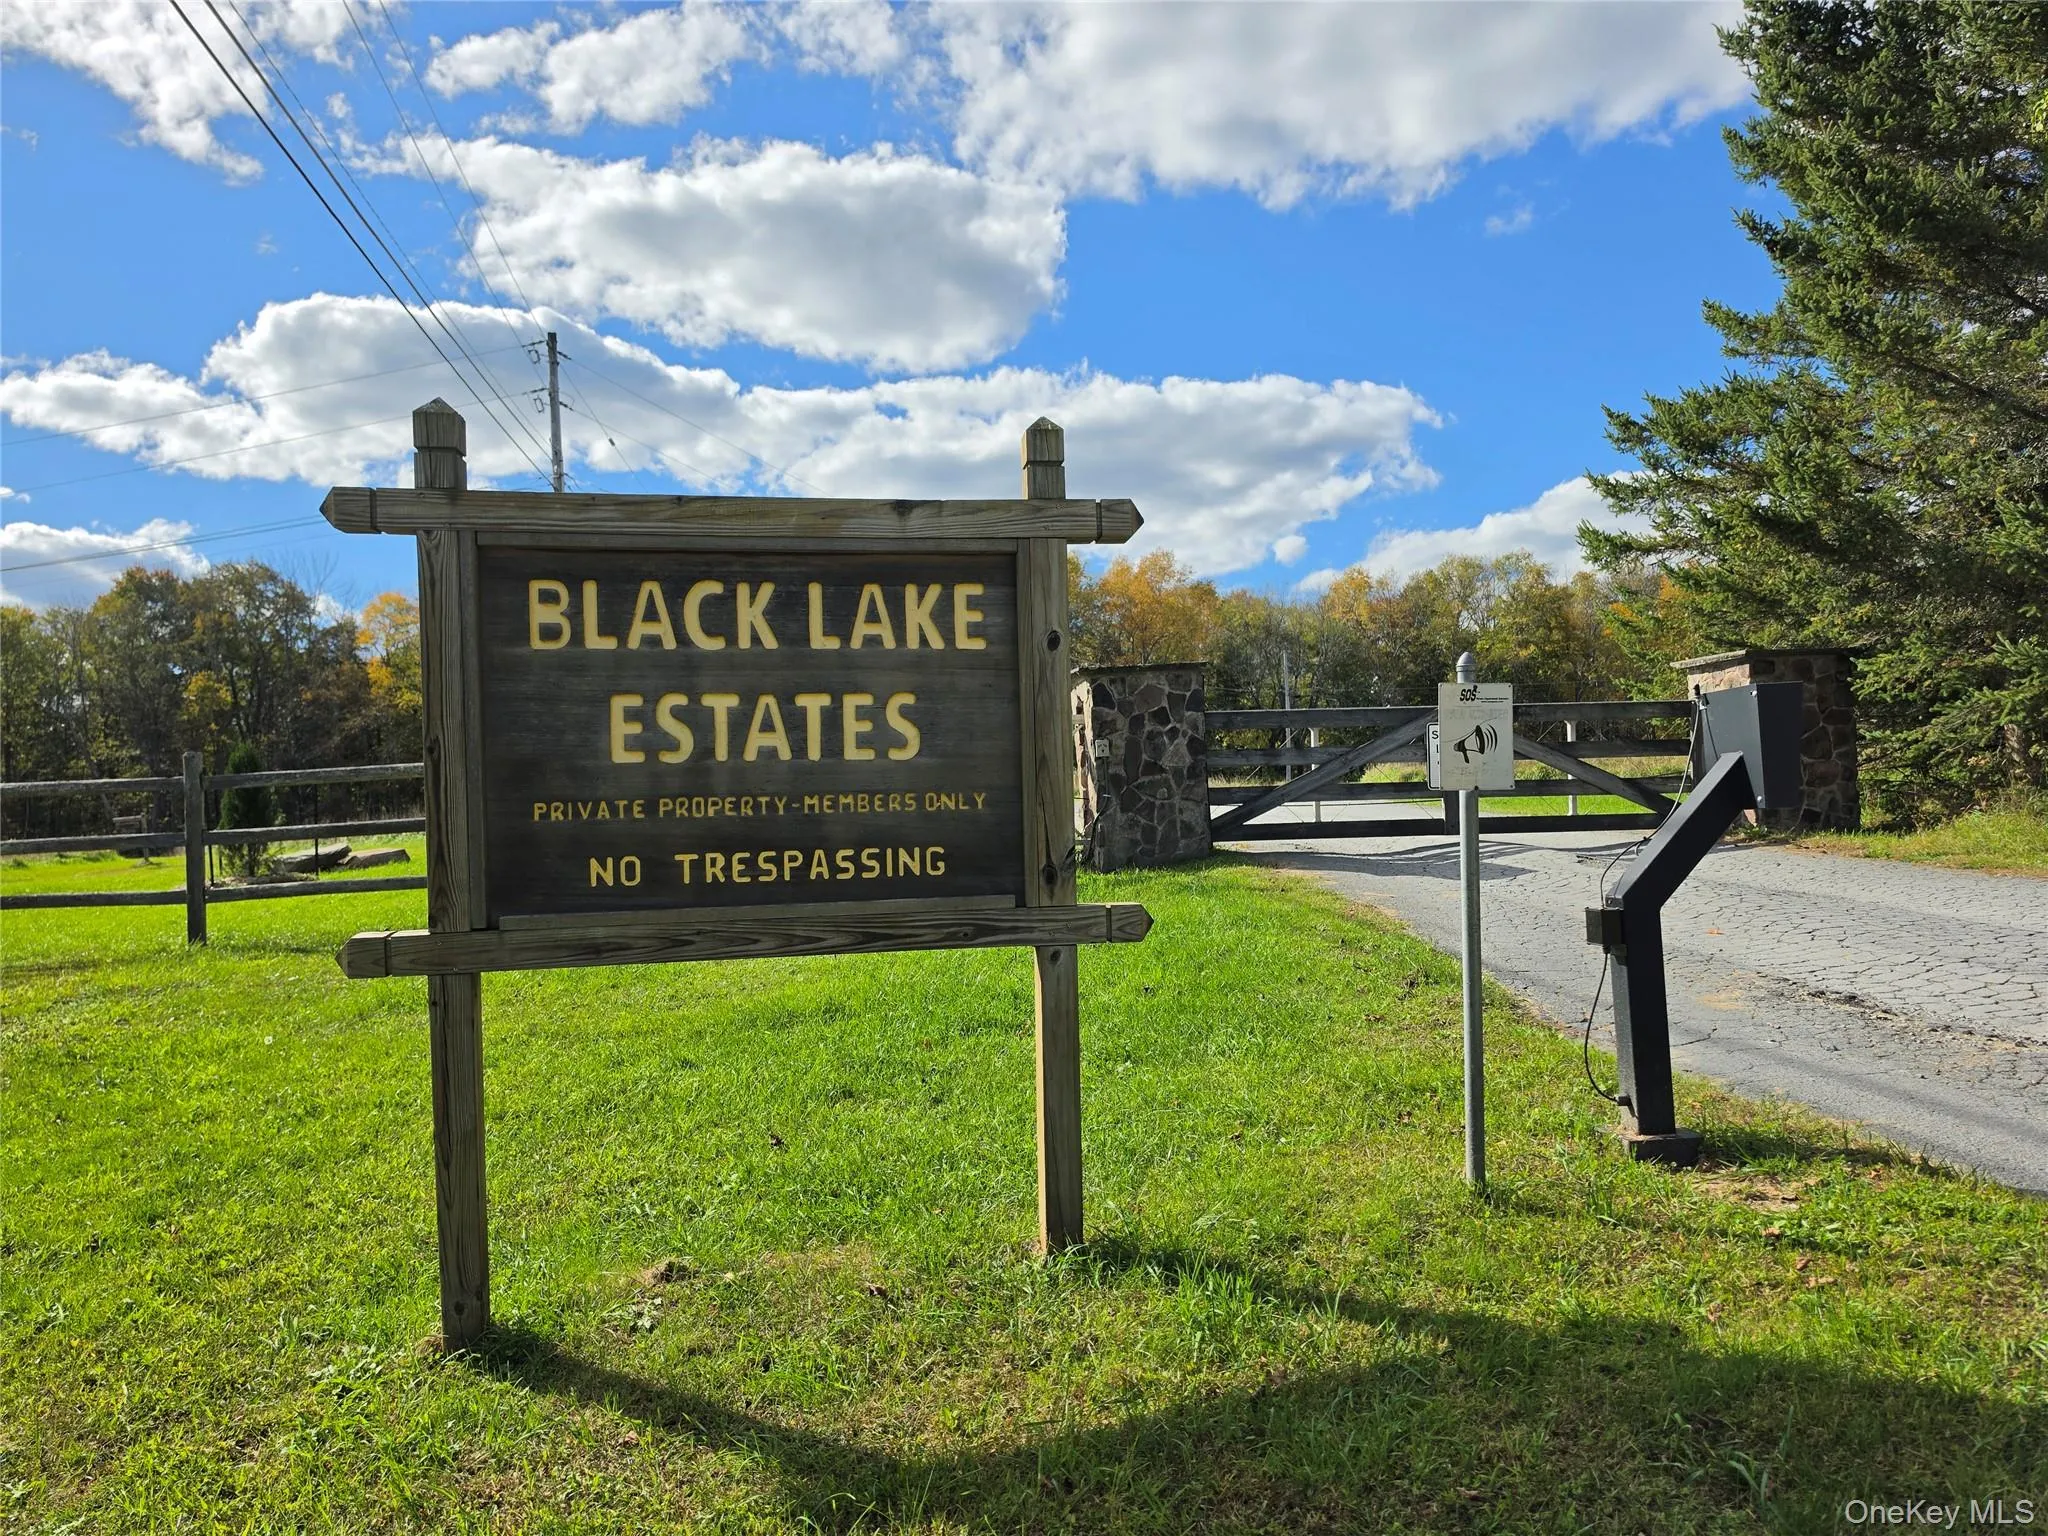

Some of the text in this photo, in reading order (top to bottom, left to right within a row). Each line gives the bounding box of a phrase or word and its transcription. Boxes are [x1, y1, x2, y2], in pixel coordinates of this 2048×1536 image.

[528, 579, 987, 650] BLACK LAKE
[1460, 688, 1477, 702] SOS
[609, 691, 922, 764] ESTATES
[533, 799, 645, 821] PRIVATE
[924, 791, 986, 812] ONLY
[589, 846, 946, 888] NO TRESPASSING
